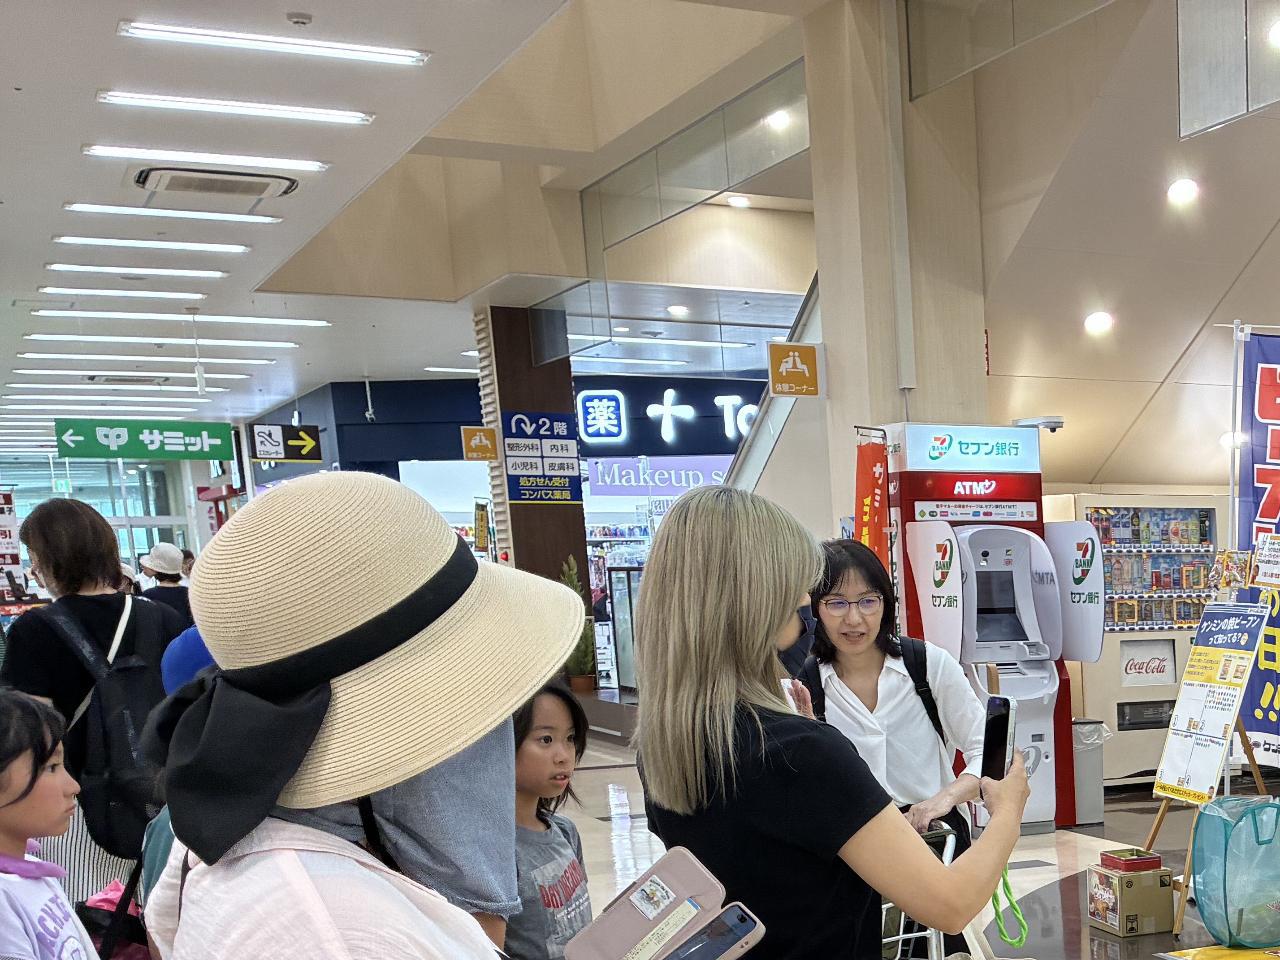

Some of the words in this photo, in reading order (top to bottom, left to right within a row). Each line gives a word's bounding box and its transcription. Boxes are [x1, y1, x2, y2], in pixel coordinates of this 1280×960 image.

[586, 399, 619, 435] 薬
[538, 417, 568, 436] 2階
[138, 428, 222, 452] サミット
[506, 442, 539, 452] 整形外科
[550, 445, 569, 454] 内科
[957, 440, 1020, 457] セブン銀行
[511, 461, 538, 472] 小児科
[548, 462, 575, 473] 皮膚科
[519, 476, 569, 487] 処方せん受付
[595, 462, 704, 489] Makeup
[520, 490, 571, 500] コンパス薬局
[953, 481, 988, 495] ATM
[931, 594, 958, 609] セブン銀行
[1070, 591, 1100, 606] セブン銀行
